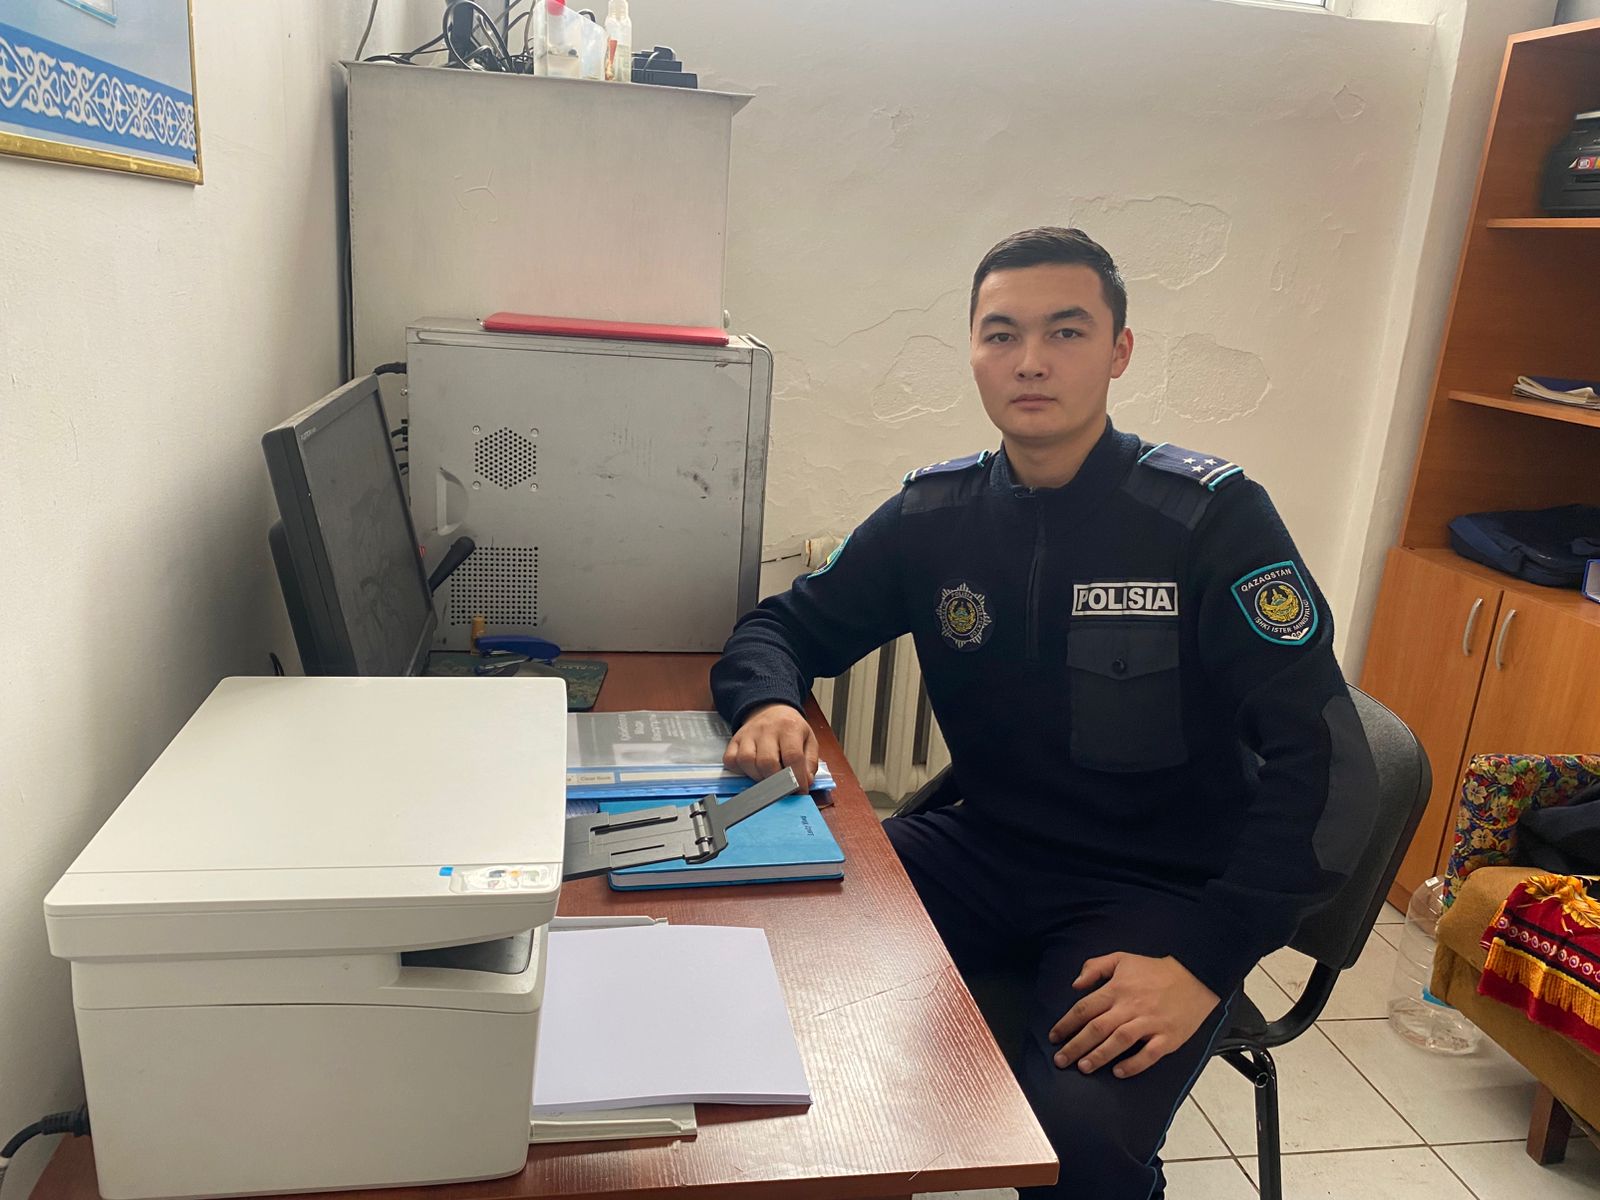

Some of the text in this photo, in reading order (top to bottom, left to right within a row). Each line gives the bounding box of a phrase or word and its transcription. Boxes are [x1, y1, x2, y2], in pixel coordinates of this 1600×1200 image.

[1240, 568, 1292, 592] QAZAQSTAN
[1077, 587, 1172, 610] POLISIA
[1271, 626, 1292, 634] ISTER
